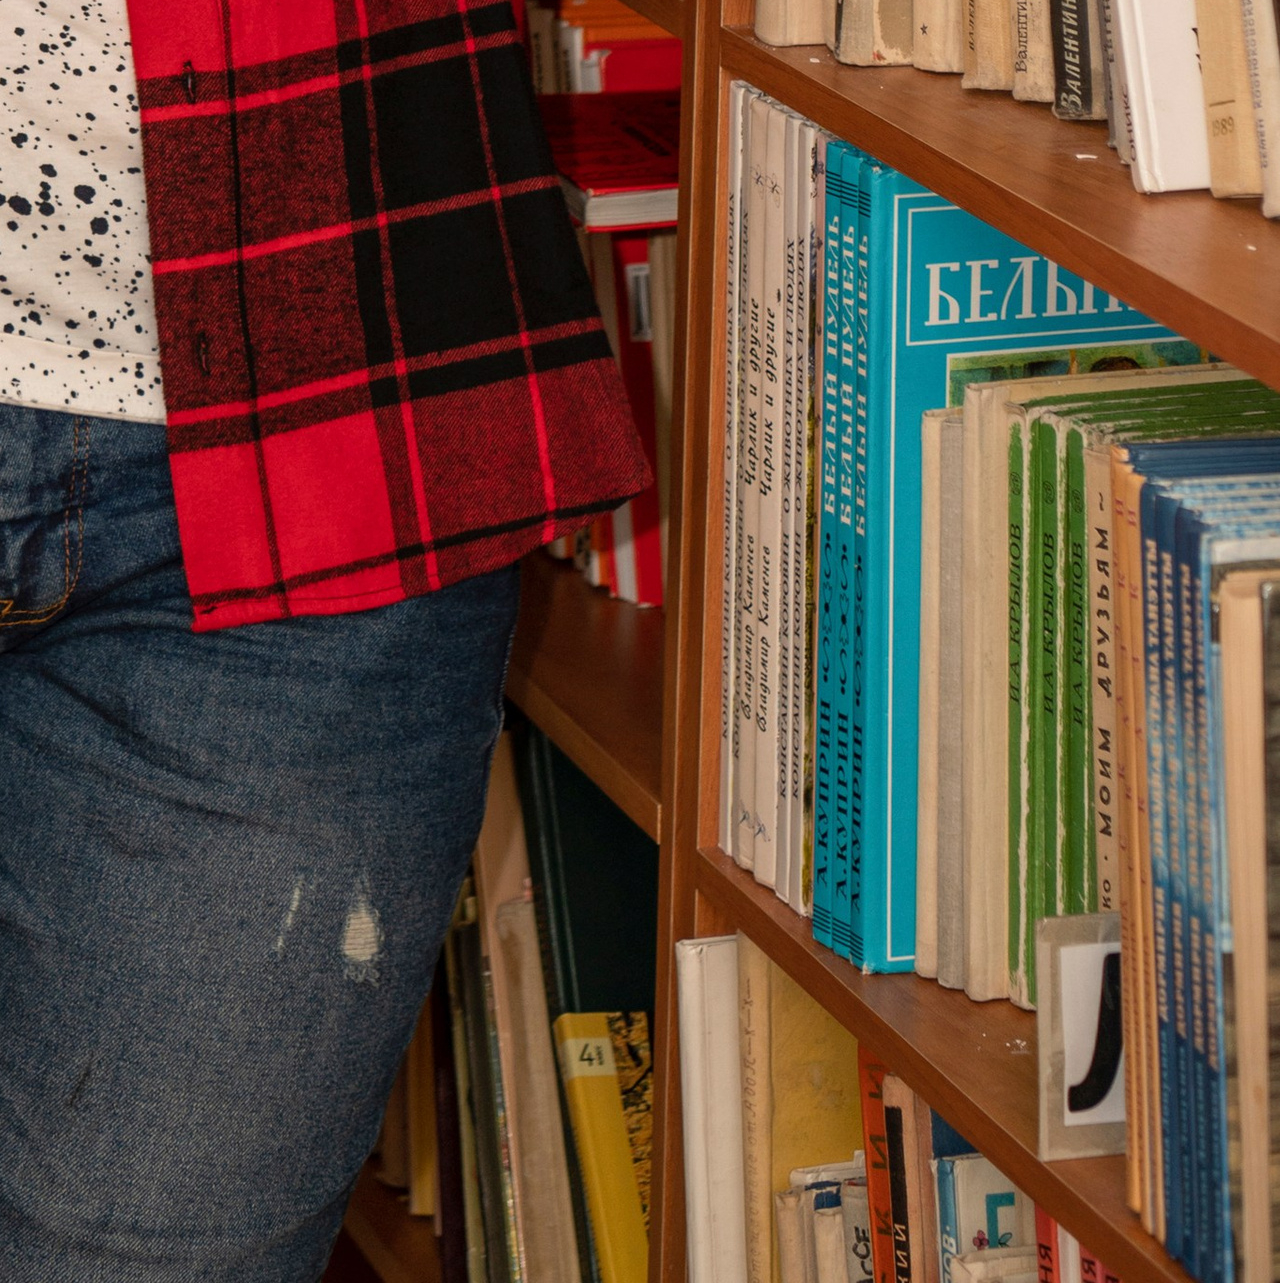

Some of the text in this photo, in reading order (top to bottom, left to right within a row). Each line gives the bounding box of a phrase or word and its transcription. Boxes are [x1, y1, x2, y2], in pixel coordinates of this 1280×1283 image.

[1211, 117, 1236, 138] 1989
[782, 237, 795, 513] О ЖИВОТНЫХ И ЛЮДЯХ
[821, 215, 841, 515] БЕЛЫЙ ПУДЕЛЬ
[835, 224, 855, 525] БЕЛЫЙ ПУДЕЛЬ
[924, 256, 1135, 326] БЕЛЫ
[743, 297, 762, 485] Чарлик и другие
[759, 306, 779, 496] Чарлик и другие
[854, 234, 869, 537] БЕЛЫЙ ПУДЕЛЬ
[740, 533, 756, 719] Владимир Каменев
[755, 544, 772, 731] Владимир Каменев
[778, 530, 791, 798] КОНСТАНТИН КОРОВИН
[791, 530, 802, 798] КОНСТАНТИН КОРОВИН
[1007, 523, 1021, 642] КРЫЛОВ
[1042, 532, 1056, 652] КРЫЛОВ
[1071, 542, 1083, 663] КРЫЛОВ
[1092, 525, 1114, 837] МОИМ ДРУЗЬЯМ
[816, 699, 831, 887] А.КУПРИН
[835, 711, 848, 899] А.КУПРИН
